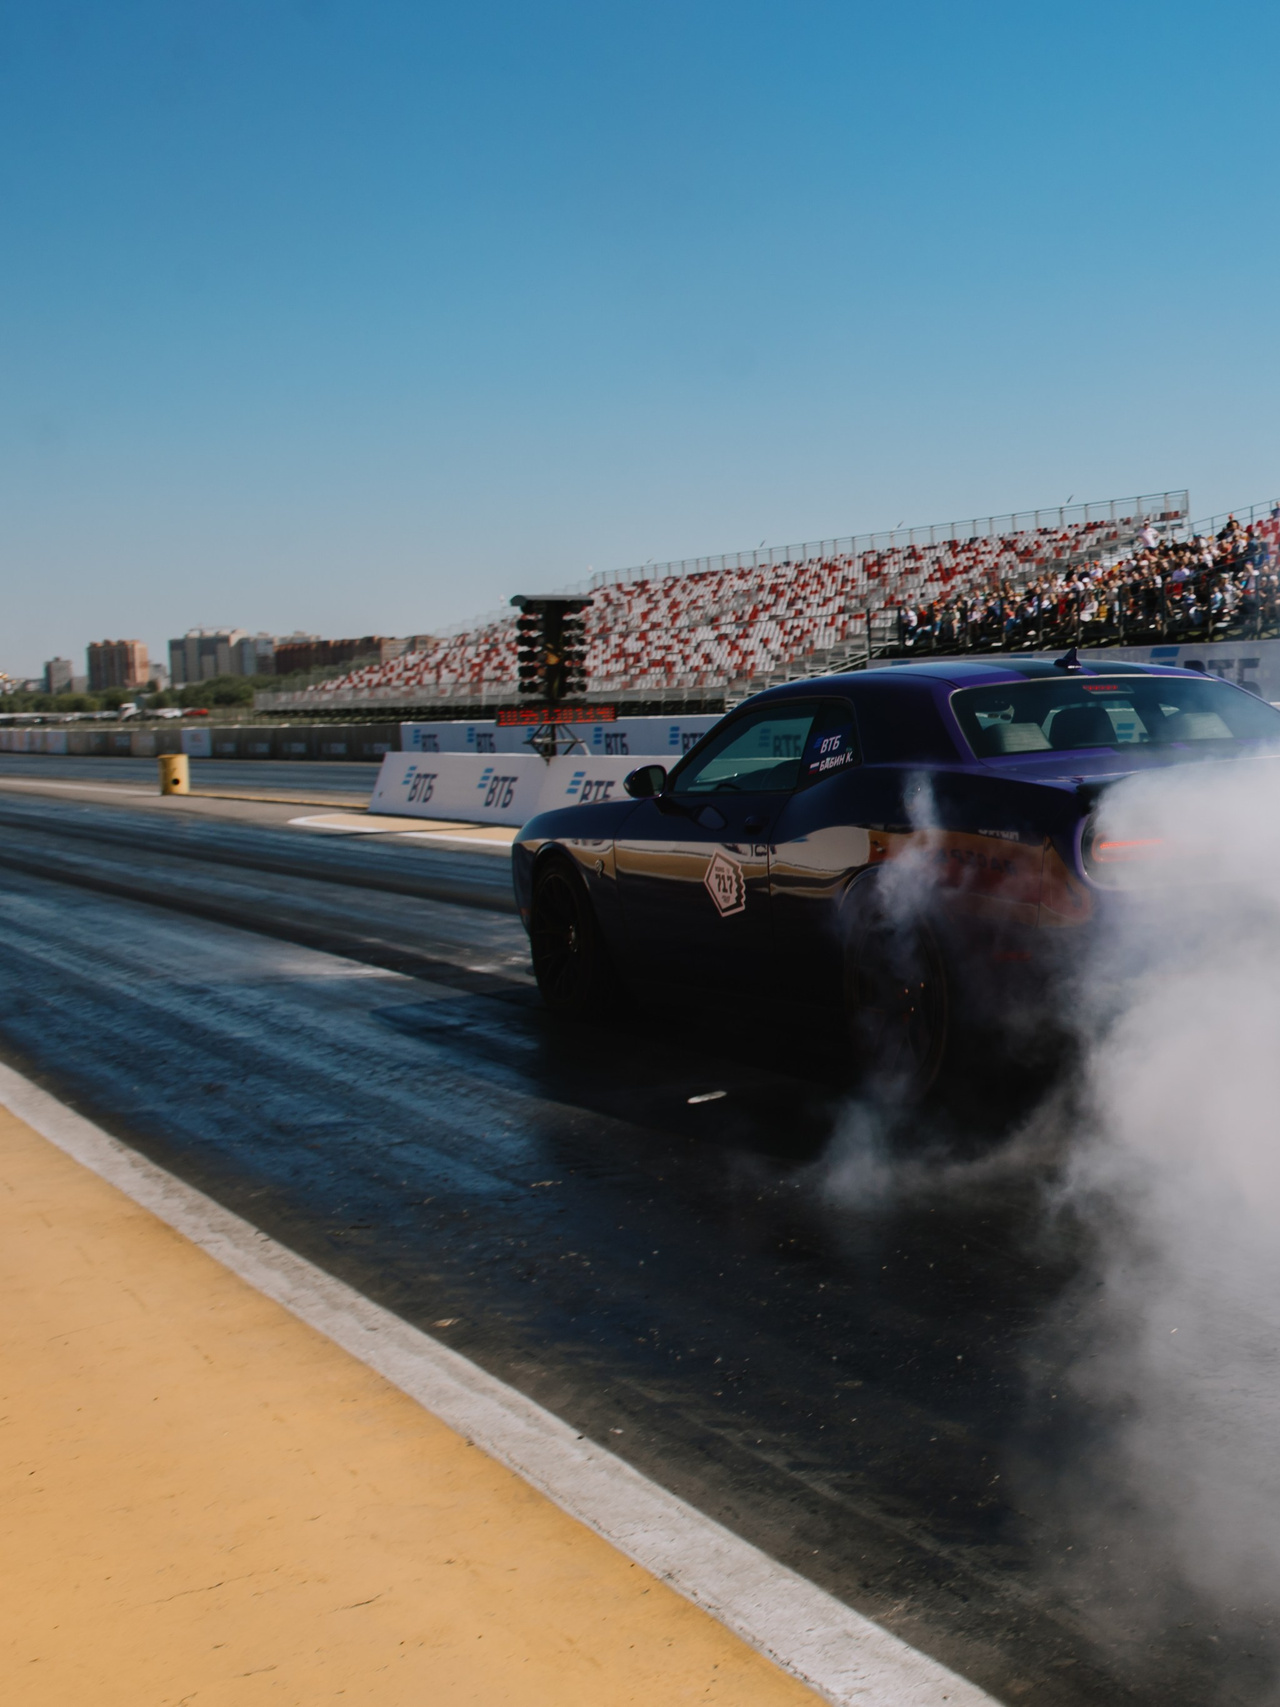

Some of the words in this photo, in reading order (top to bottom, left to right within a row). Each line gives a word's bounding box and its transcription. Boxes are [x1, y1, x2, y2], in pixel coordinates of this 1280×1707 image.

[820, 734, 842, 754] ВТБ
[407, 773, 438, 803] ВТБ
[484, 776, 519, 808] ВТБ
[715, 873, 733, 894] 717
